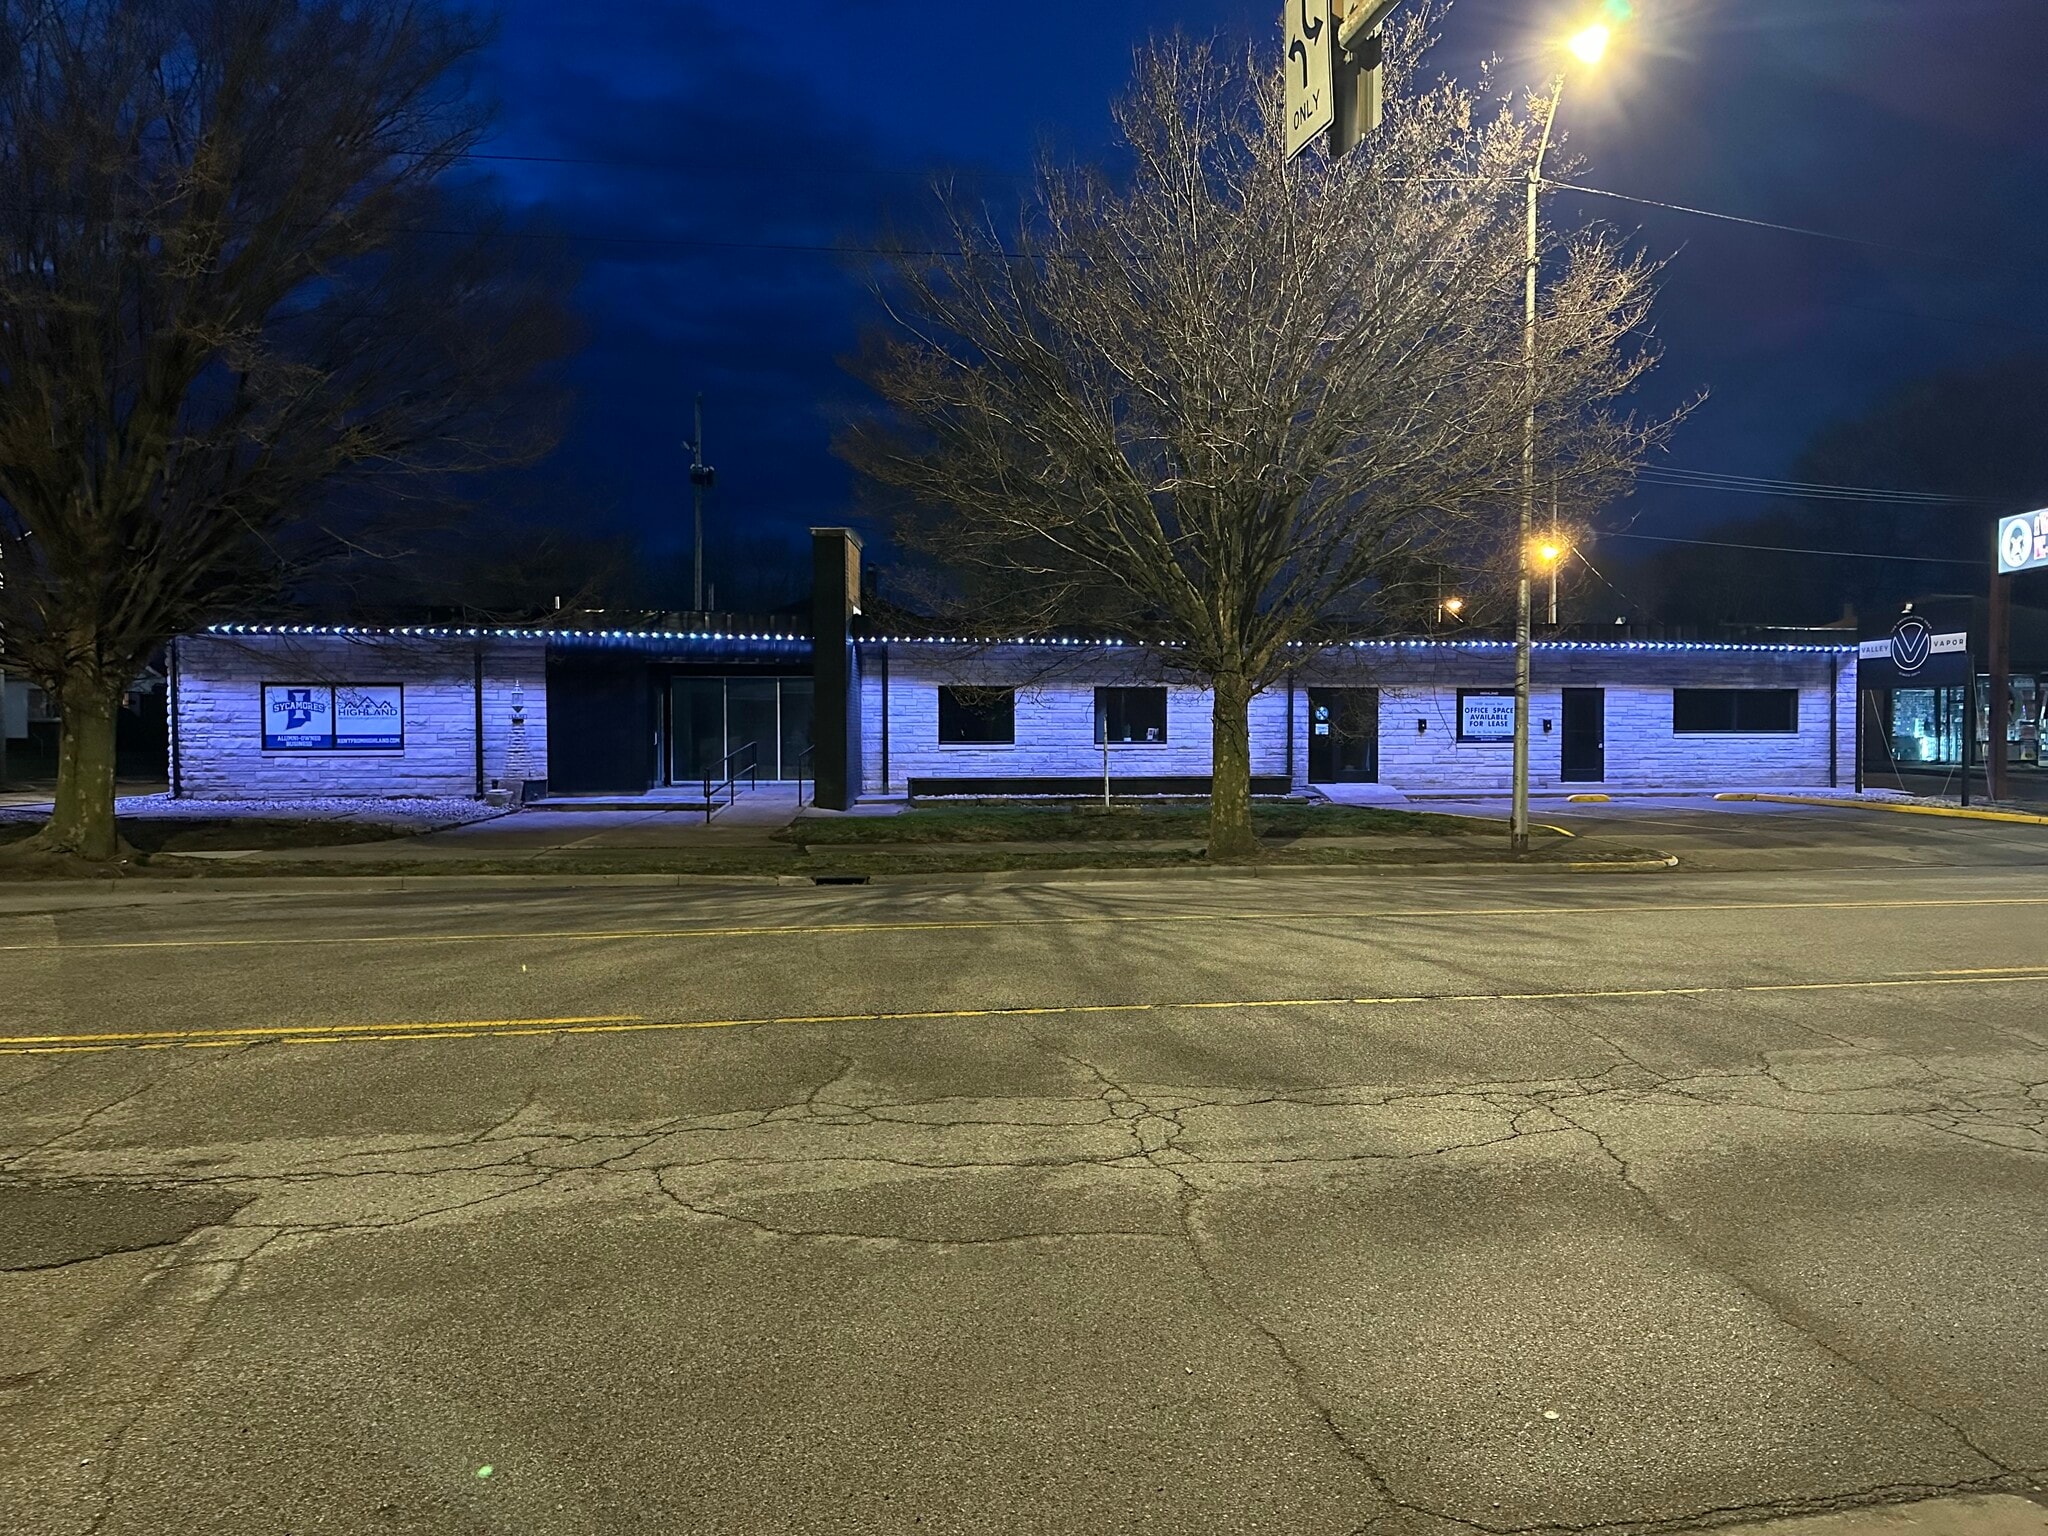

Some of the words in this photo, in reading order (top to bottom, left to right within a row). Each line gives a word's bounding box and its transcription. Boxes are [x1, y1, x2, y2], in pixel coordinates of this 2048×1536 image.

[1293, 89, 1320, 130] ONLY
[1861, 645, 1889, 653] VALLEY
[1933, 638, 1964, 647] VAPOR
[273, 701, 325, 712] SYCAMORES
[338, 708, 398, 716] HIGHLAND
